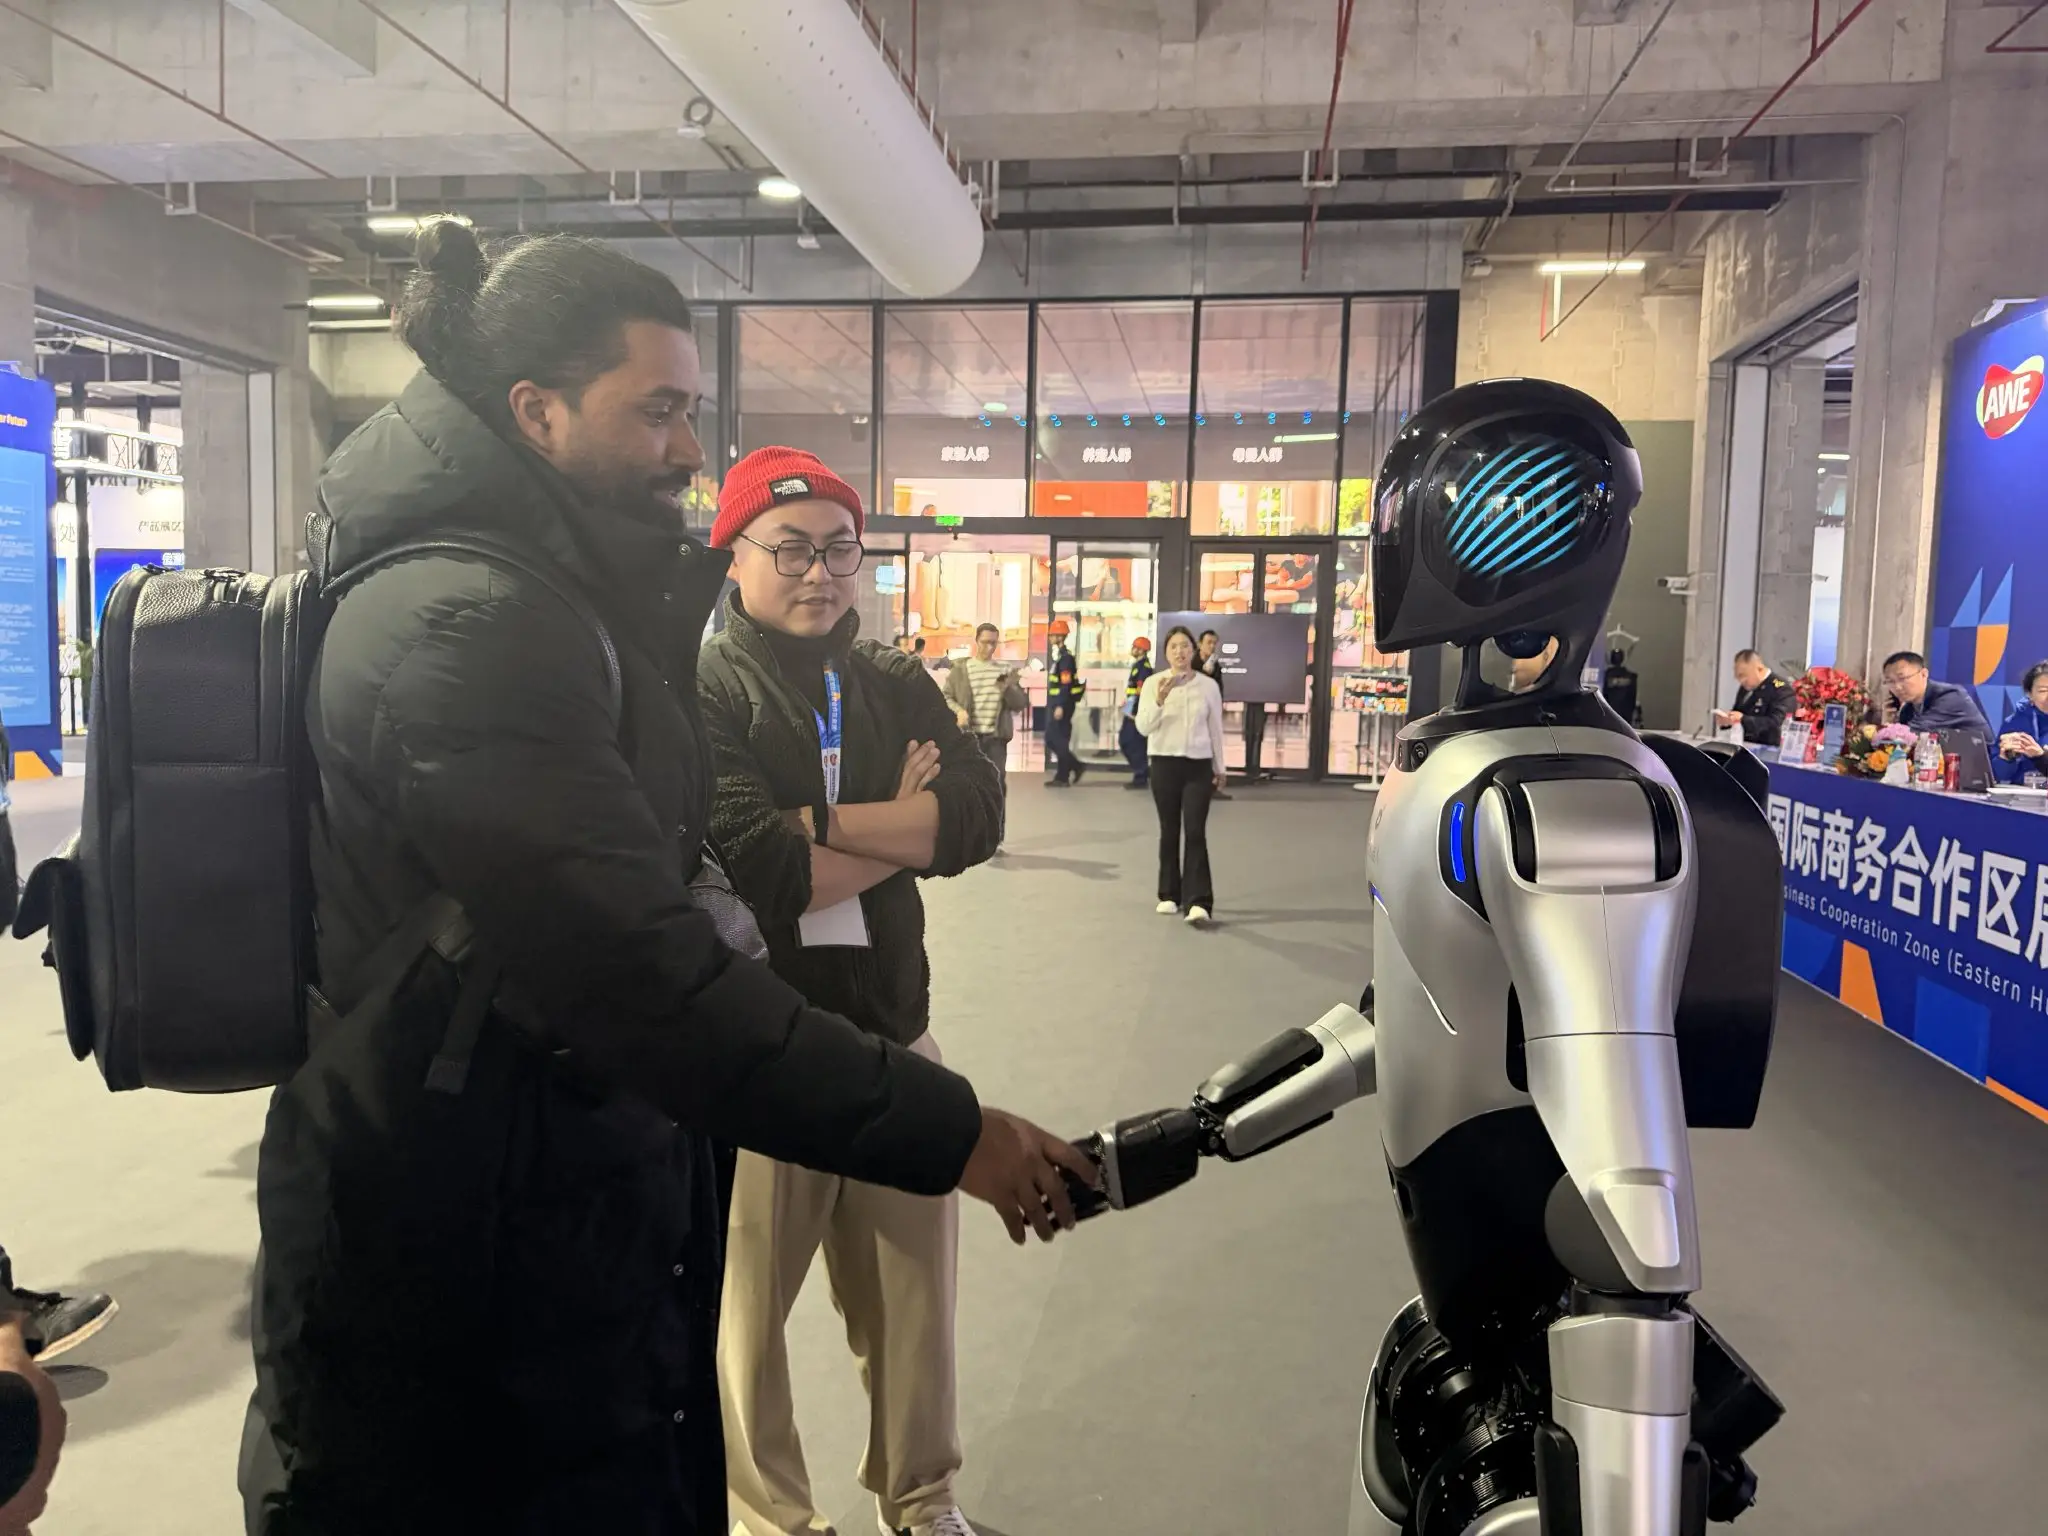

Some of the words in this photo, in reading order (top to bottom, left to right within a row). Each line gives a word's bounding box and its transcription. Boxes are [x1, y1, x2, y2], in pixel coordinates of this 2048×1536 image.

[1984, 374, 2031, 423] AWE
[1784, 884, 1815, 911] siness
[1820, 896, 1898, 947] Cooperation
[1904, 931, 1940, 965] Zone
[1947, 949, 2021, 1003] (Eastern
